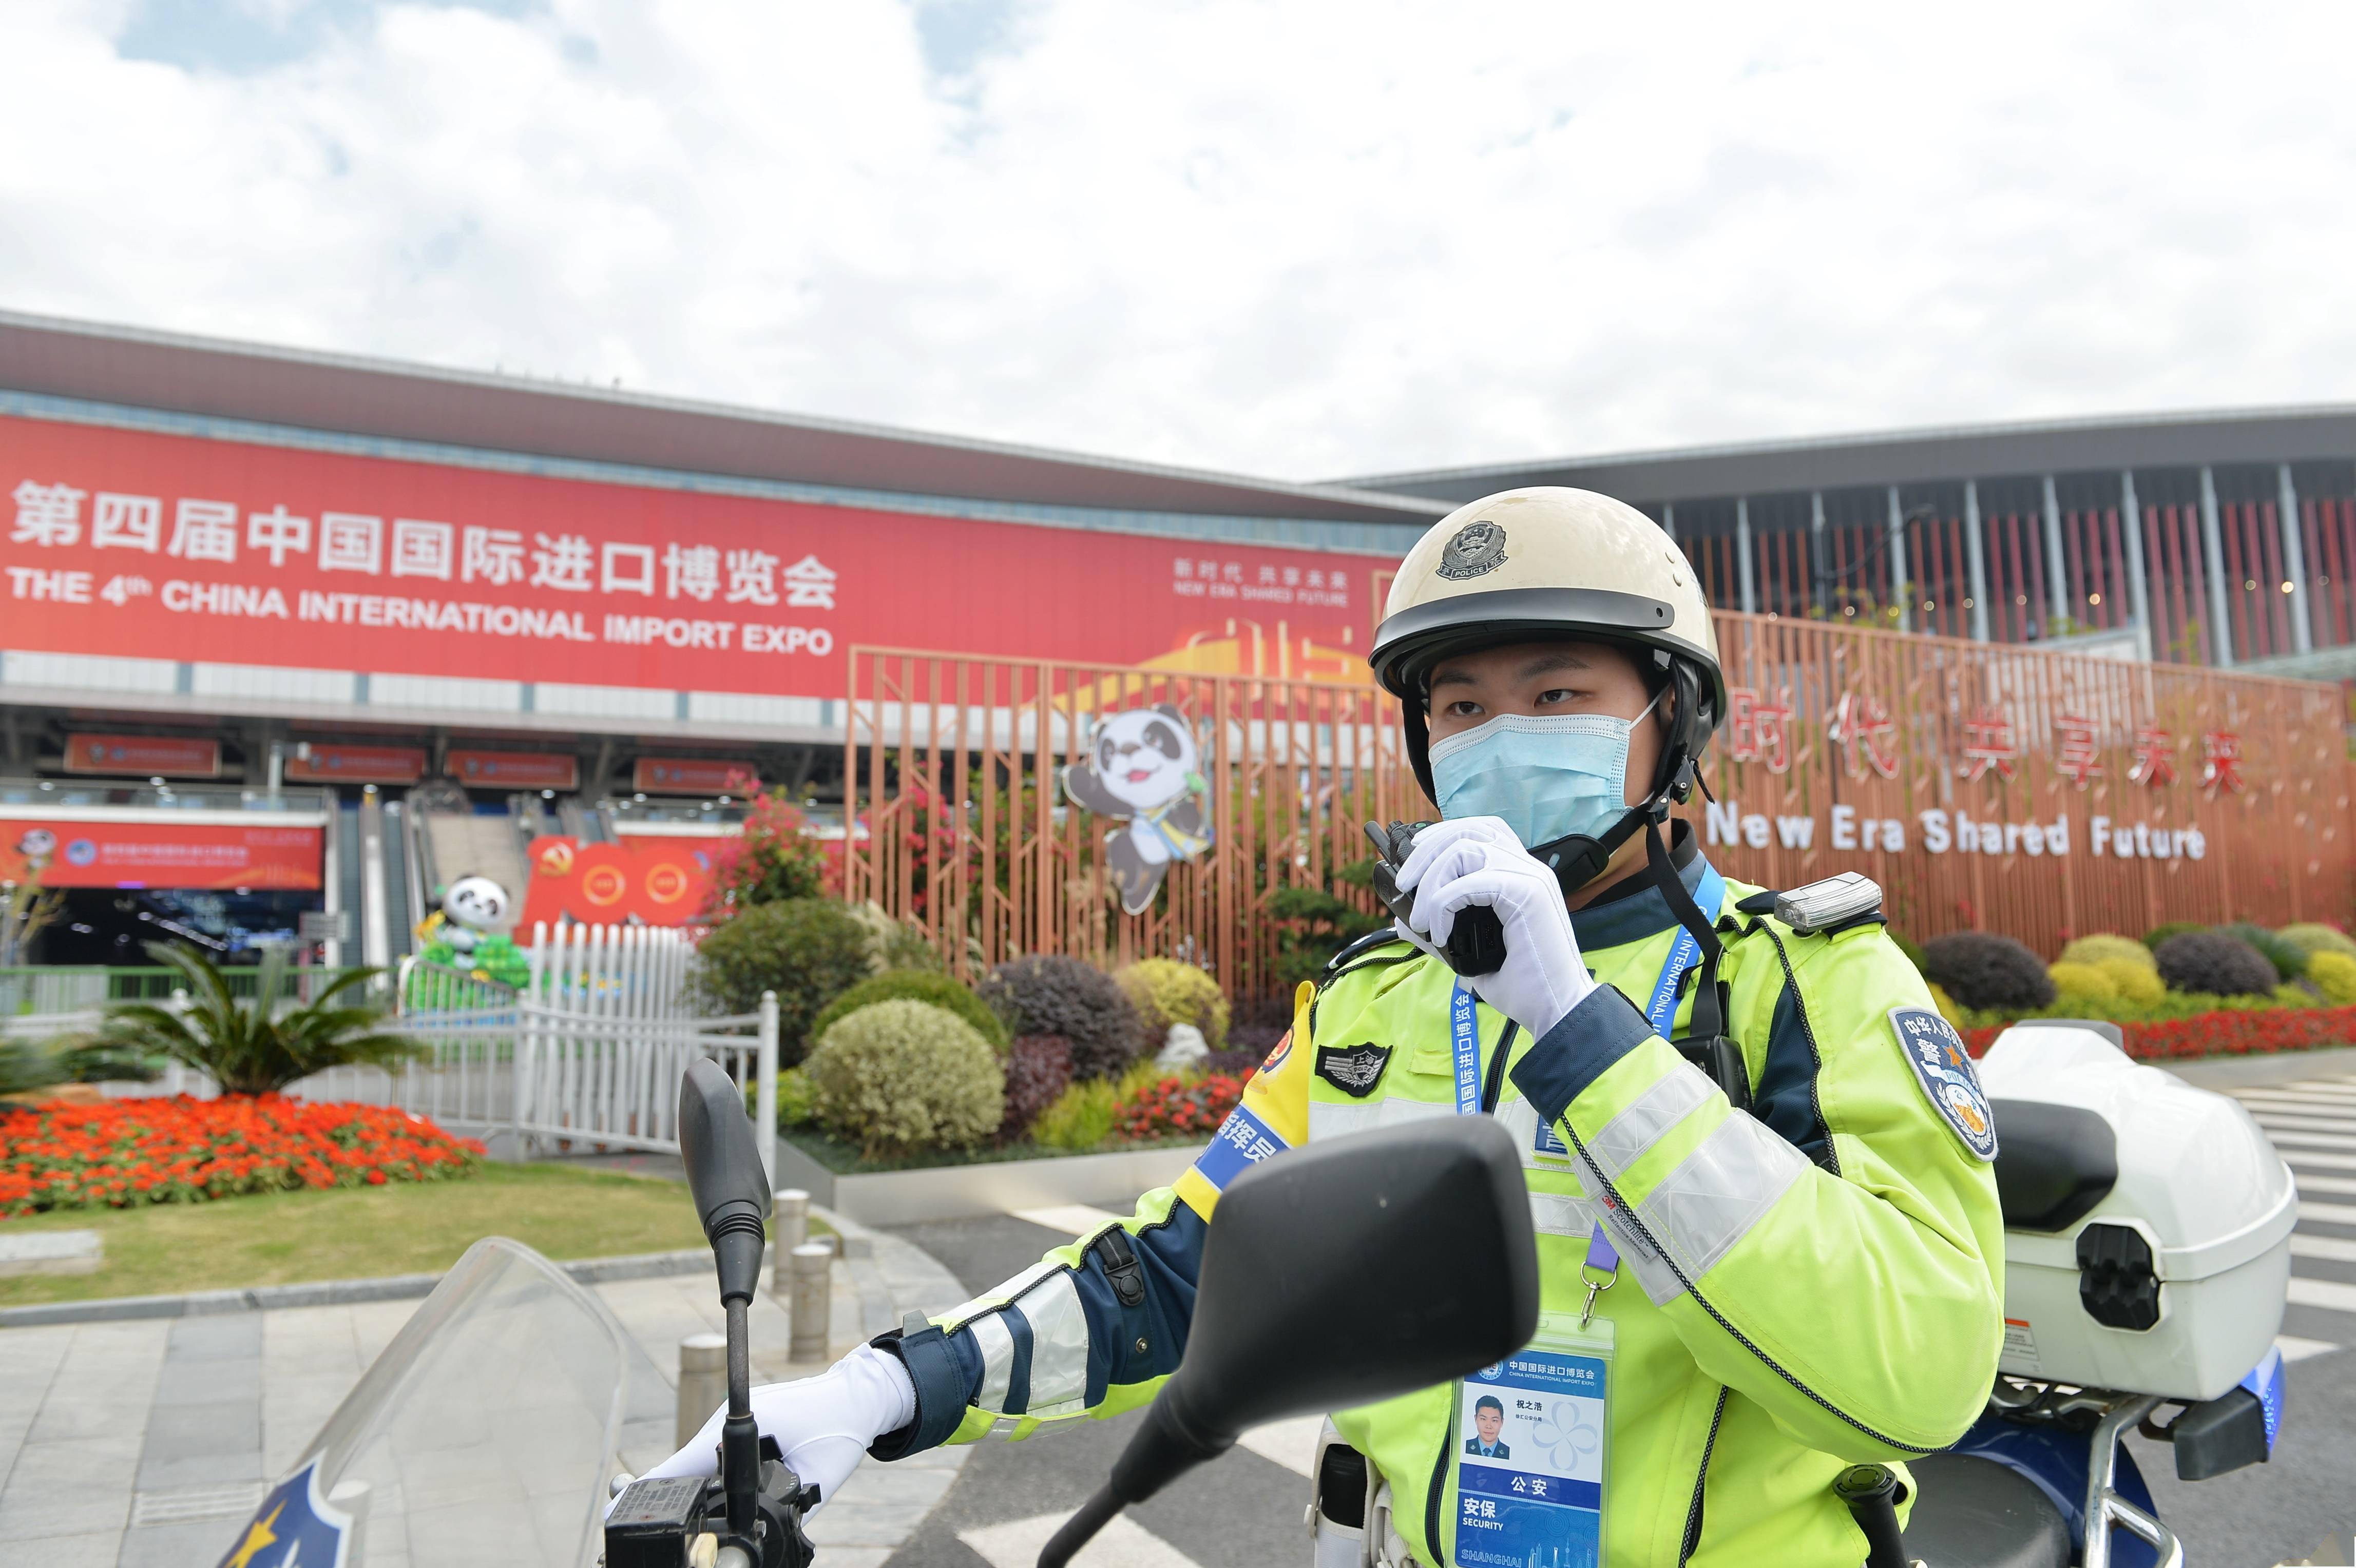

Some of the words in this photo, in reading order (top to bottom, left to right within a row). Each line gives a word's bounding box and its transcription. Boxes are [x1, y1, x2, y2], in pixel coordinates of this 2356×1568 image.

[10, 479, 837, 610] 第四届中国国际进口博览会
[1455, 566, 1484, 577] POLICE
[1173, 580, 1207, 597] NEW
[1209, 583, 1238, 599] ERA
[1240, 585, 1293, 604] SHARED
[1297, 589, 1349, 608] FUTURE
[7, 567, 94, 604] THE
[101, 574, 152, 606] 4th
[161, 579, 290, 619] CHINA
[298, 590, 595, 642] INTERNATIONAL
[604, 614, 736, 650] IMPORT
[742, 624, 833, 657] EXPO
[1706, 800, 1814, 849] New
[1831, 804, 1906, 853] Era
[1919, 808, 2069, 857] Shared
[2091, 815, 2206, 860] Future
[1651, 939, 1694, 1021] INTERNATIONAL
[1455, 994, 1476, 1116] 国国际进口博览会
[1602, 1195, 1616, 1210] 3M
[1608, 1214, 1630, 1239] Reflective
[1509, 1361, 1595, 1380] 中国国际进口博览会
[1524, 1374, 1561, 1382] INTERNATIONAL
[1516, 1399, 1543, 1411] 祝之浩
[1511, 1476, 1547, 1497] 公安
[1464, 1497, 1496, 1519] 安保
[1463, 1517, 1504, 1531] SECURITY
[1461, 1549, 1522, 1568] SHANGHAI
